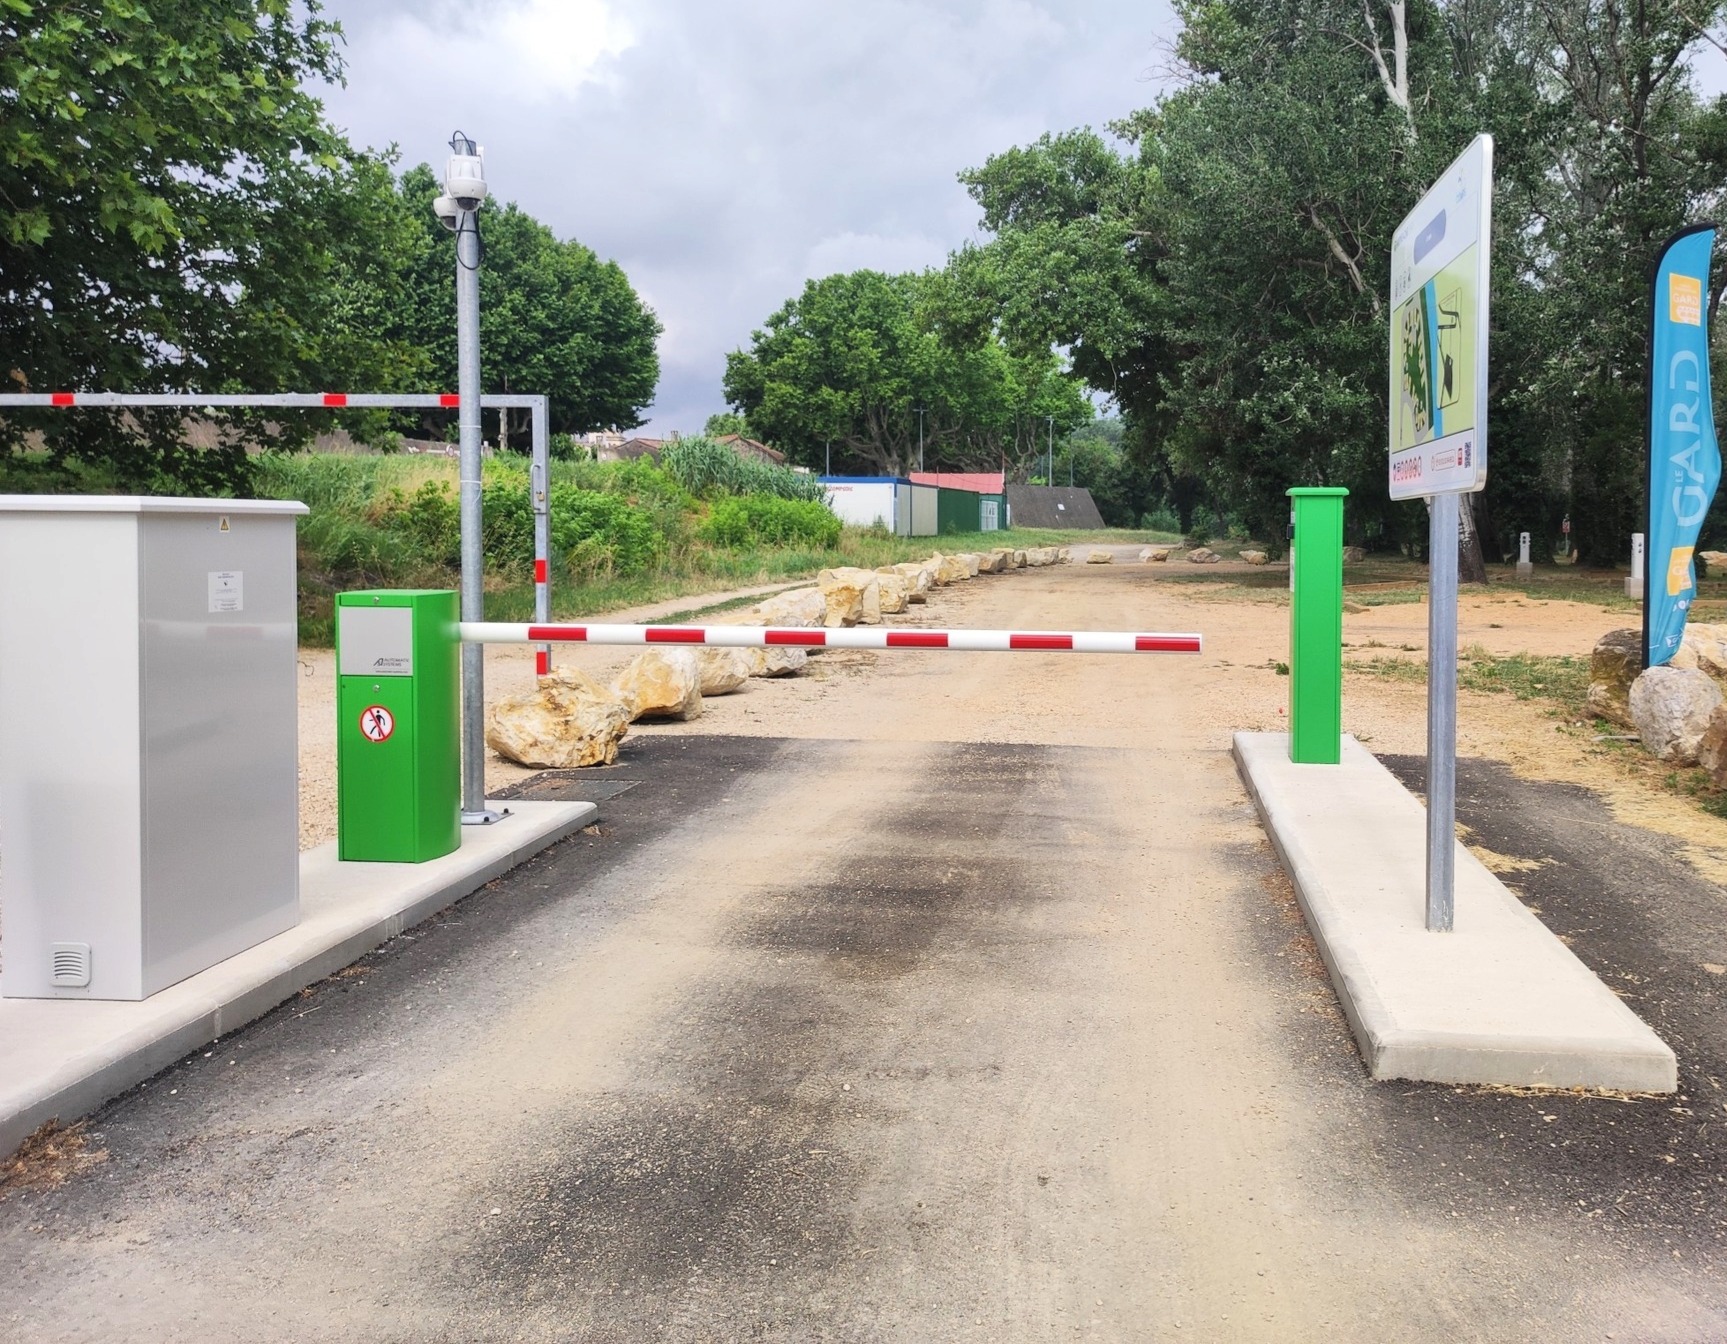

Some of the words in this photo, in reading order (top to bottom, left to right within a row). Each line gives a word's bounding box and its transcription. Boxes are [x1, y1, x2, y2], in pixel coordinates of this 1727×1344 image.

[1672, 293, 1699, 306] GARD
[1669, 350, 1708, 527] GARD
[1675, 469, 1684, 483] LE
